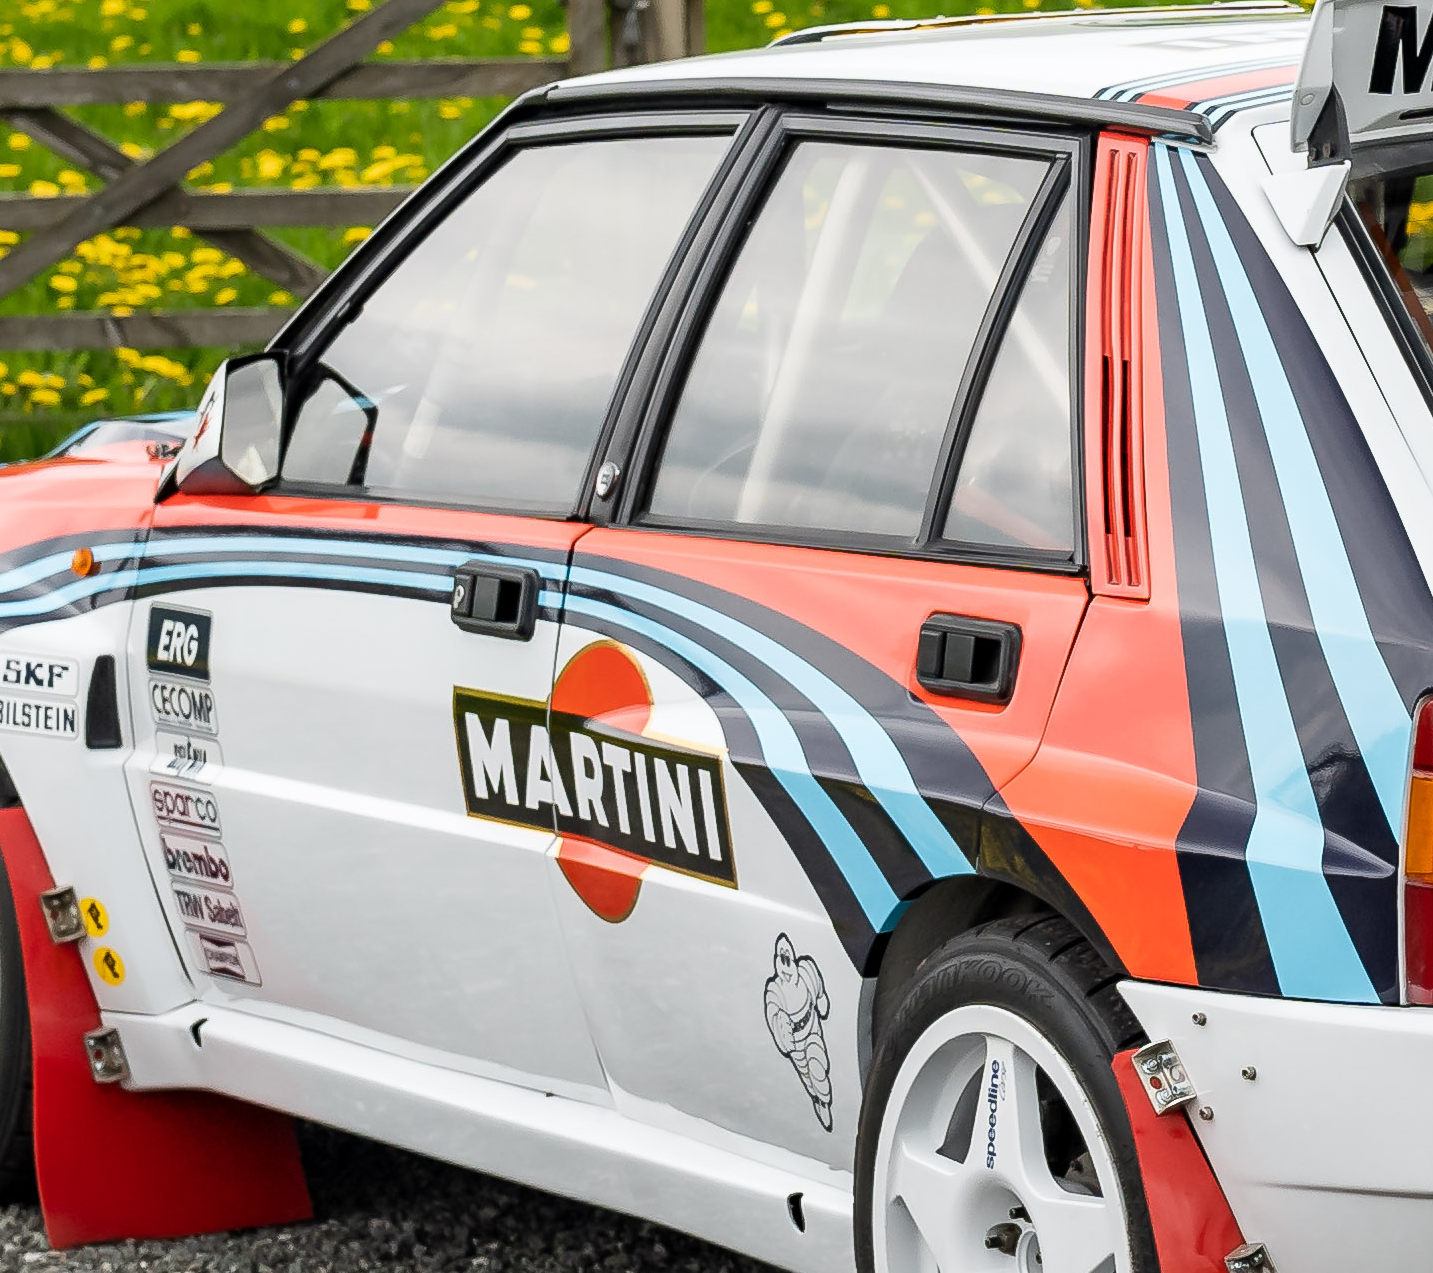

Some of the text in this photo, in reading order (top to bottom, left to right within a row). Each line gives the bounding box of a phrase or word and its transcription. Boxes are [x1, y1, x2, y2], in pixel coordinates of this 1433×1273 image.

[157, 619, 199, 666] ERG
[3, 659, 69, 687] SKF
[152, 683, 213, 723] CECOMP
[153, 789, 217, 823] sparco
[465, 711, 723, 862] MARTINI
[161, 837, 230, 882] brembo
[986, 1058, 1000, 1170] speedline
